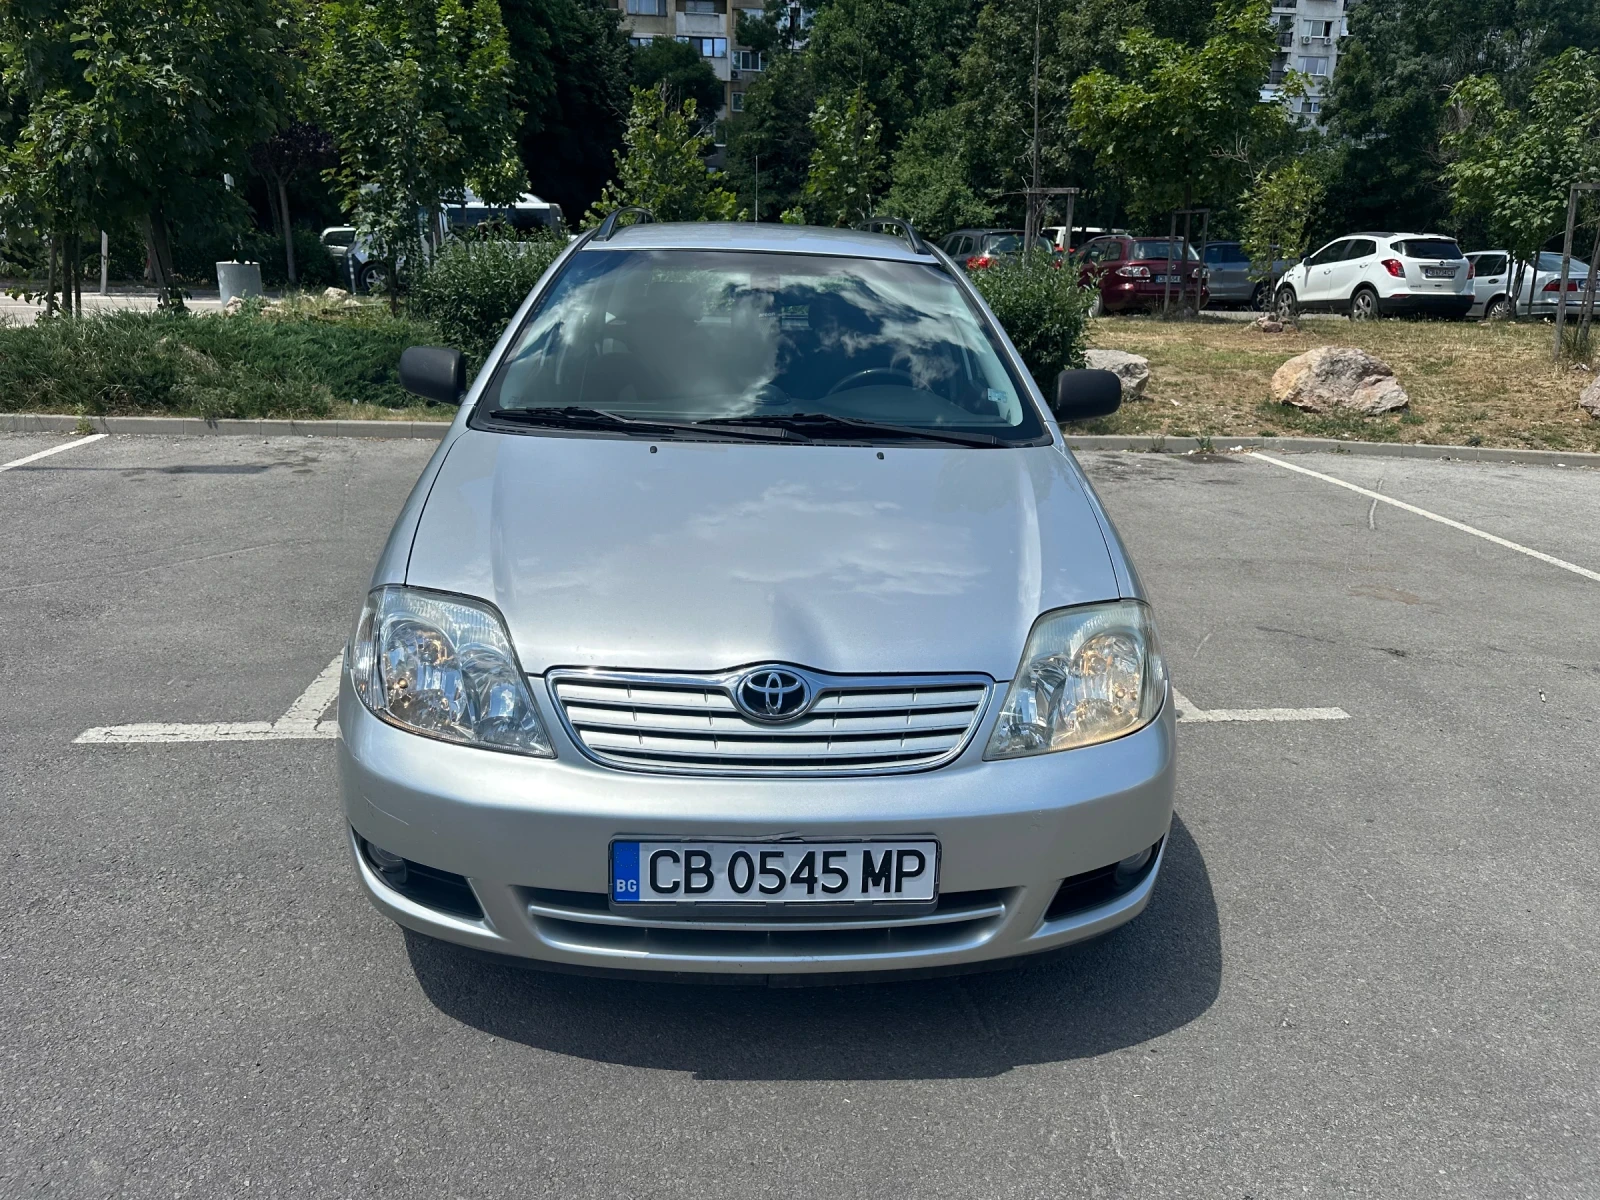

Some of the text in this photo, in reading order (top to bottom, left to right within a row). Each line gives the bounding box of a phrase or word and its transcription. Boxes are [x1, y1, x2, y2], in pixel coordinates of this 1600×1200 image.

[616, 879, 637, 893] BG
[649, 850, 926, 894] CB 0545 MP
